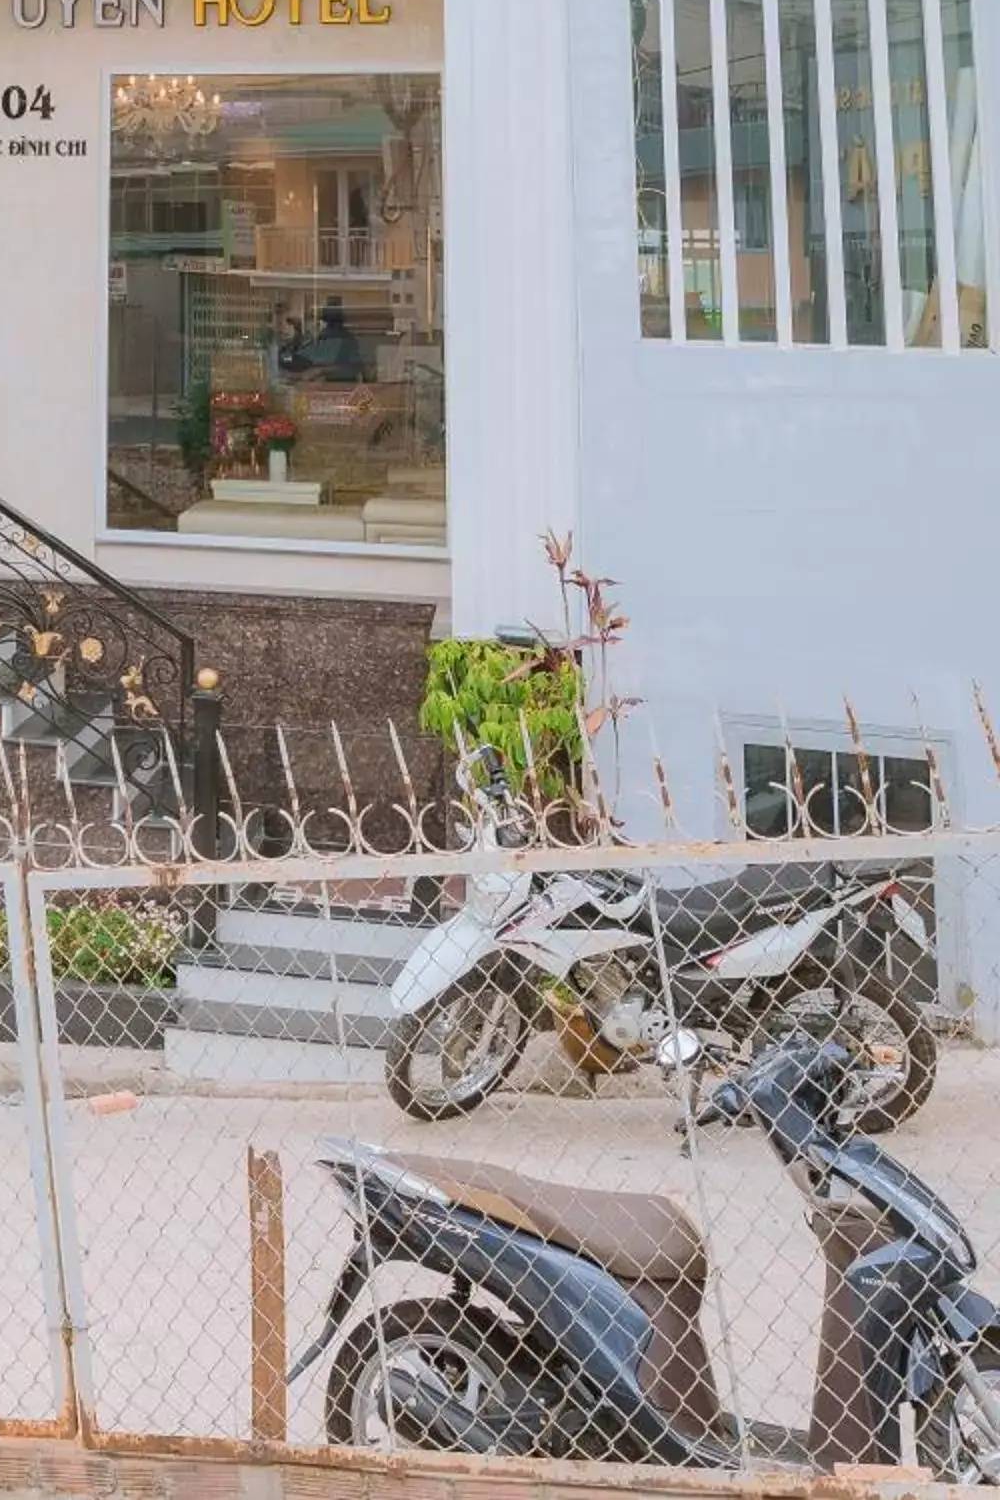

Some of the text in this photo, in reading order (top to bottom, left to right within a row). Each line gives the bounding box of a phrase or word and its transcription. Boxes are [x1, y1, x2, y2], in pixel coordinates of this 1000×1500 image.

[1, 84, 56, 121] 04
[8, 135, 50, 157] ĐÌNH
[55, 139, 87, 157] CHI
